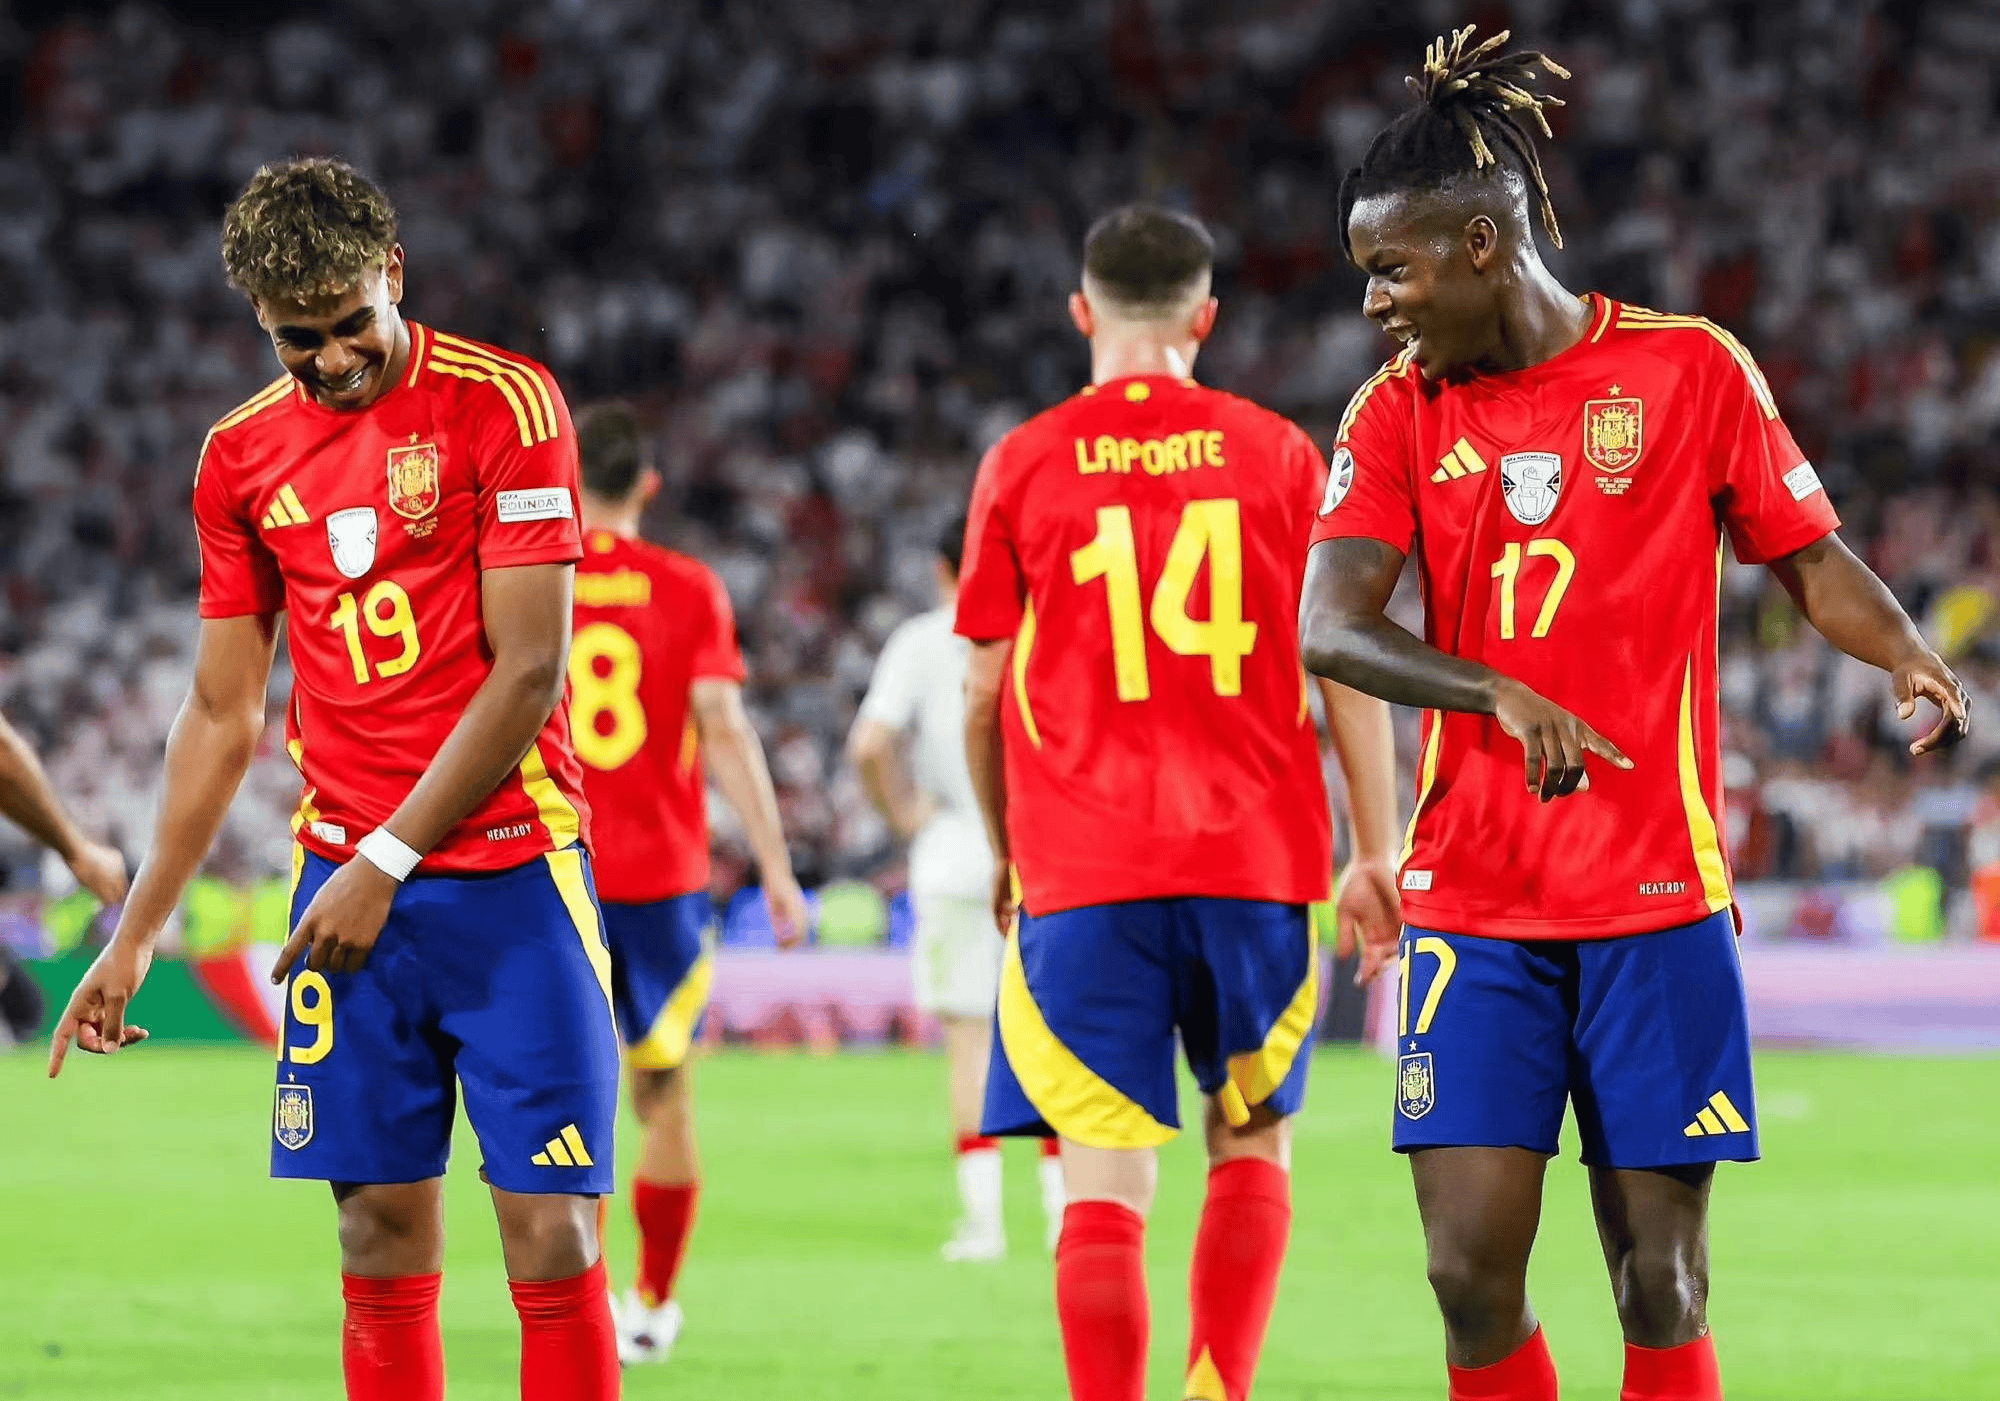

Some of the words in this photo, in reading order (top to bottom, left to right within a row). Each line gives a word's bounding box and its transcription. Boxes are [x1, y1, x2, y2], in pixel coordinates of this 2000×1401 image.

[1074, 429, 1226, 476] LAPORTE
[330, 580, 420, 685] 19
[1070, 498, 1258, 702] 14
[1491, 538, 1576, 640] 17
[567, 622, 647, 771] 8
[487, 823, 531, 841] HEAT.RDY
[1639, 881, 1686, 895] HEAT.RDY
[1399, 936, 1457, 1037] 17
